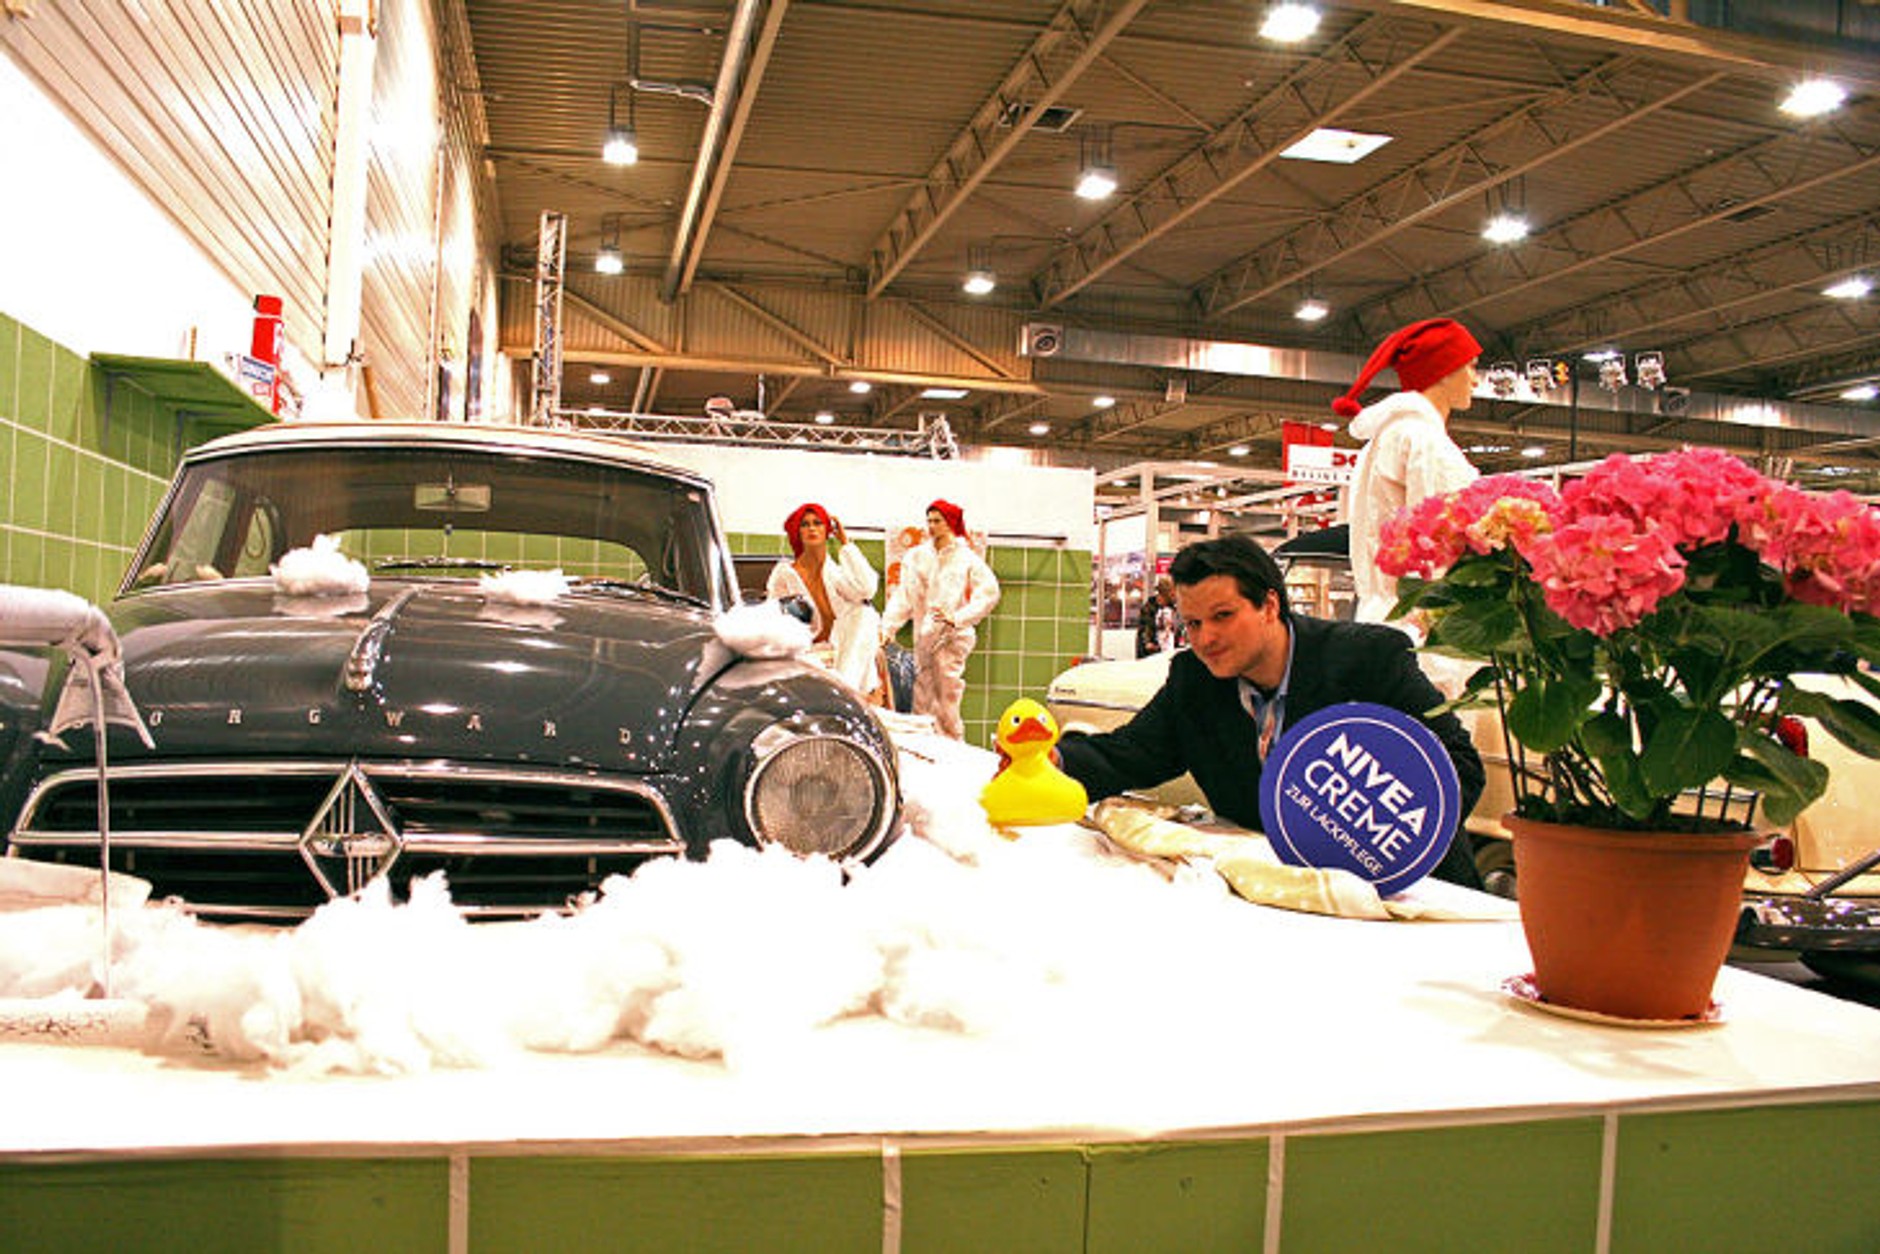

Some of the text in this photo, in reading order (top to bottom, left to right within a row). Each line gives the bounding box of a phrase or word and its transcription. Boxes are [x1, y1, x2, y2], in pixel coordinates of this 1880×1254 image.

[148, 708, 632, 745] ORGWARD
[1285, 783, 1384, 876] ZUR LACKPFLEGE
[1304, 760, 1412, 861] CREME
[1325, 732, 1427, 836] NIVEA
